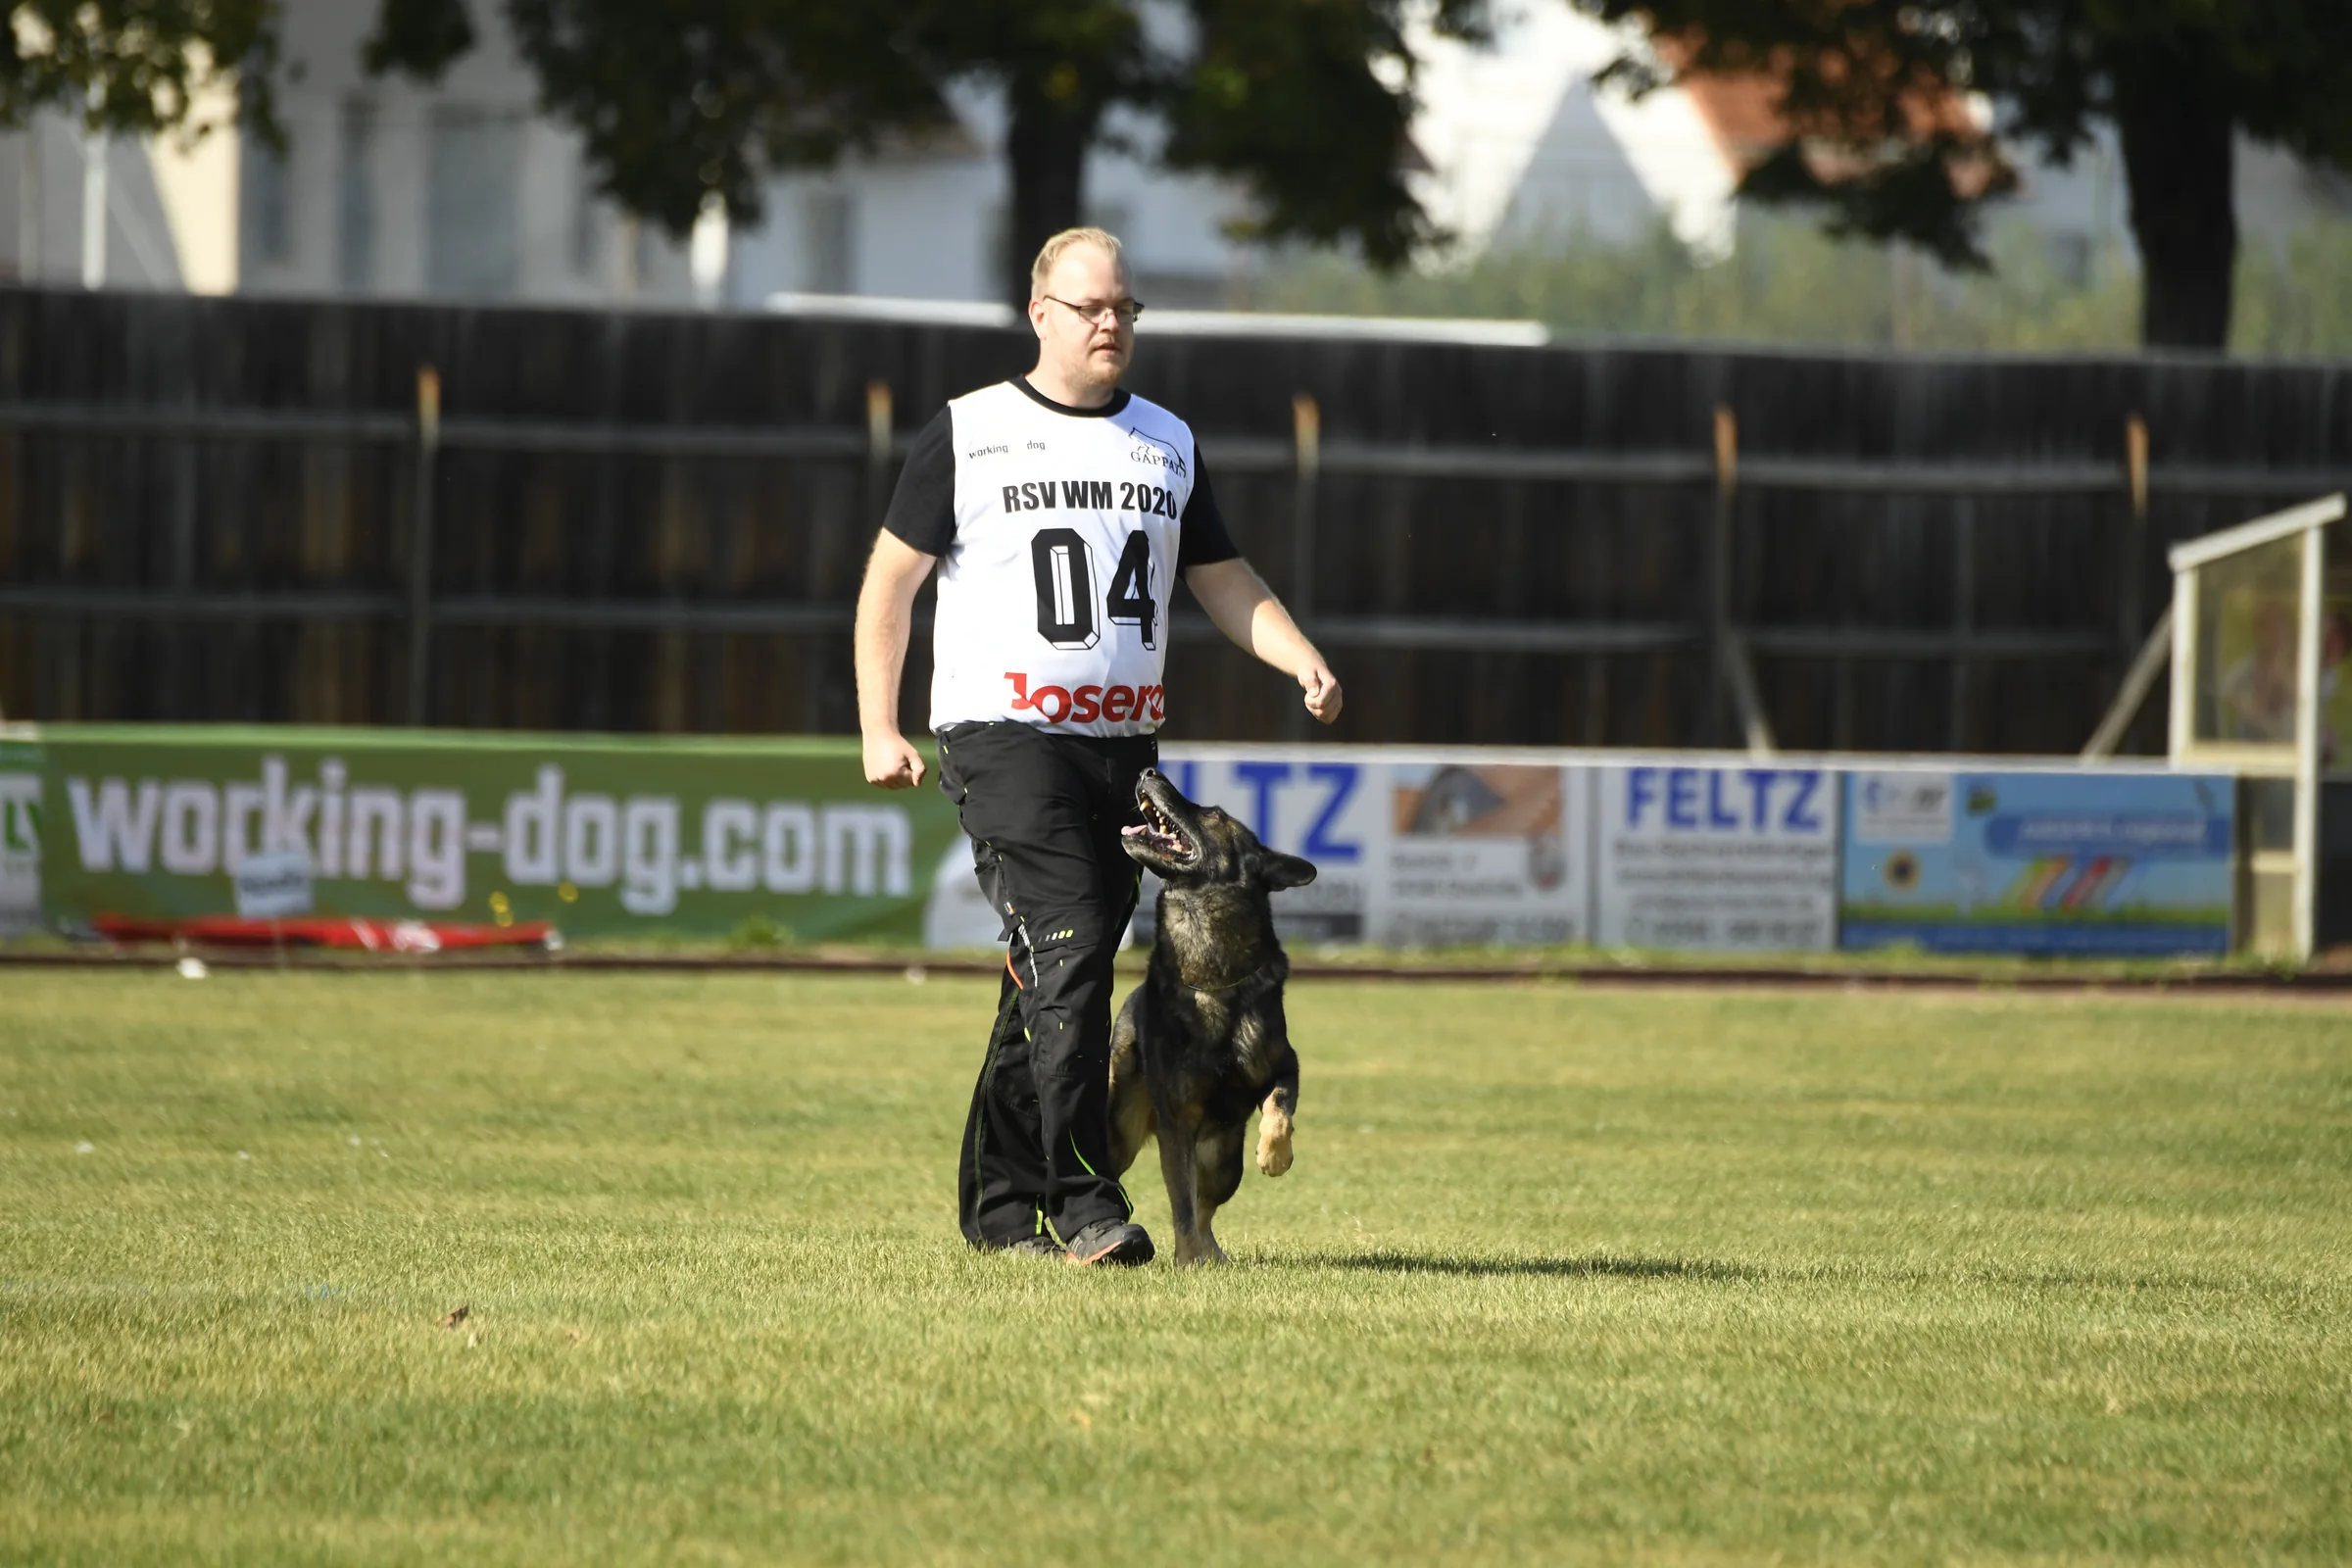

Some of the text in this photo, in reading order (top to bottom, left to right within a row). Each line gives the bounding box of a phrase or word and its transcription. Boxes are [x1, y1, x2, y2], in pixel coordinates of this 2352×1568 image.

[968, 439, 1046, 460] working dog
[1002, 480, 1177, 520] RSV WM 2020
[1030, 527, 1159, 652] 04
[1624, 767, 1824, 831] FELTZ
[67, 753, 912, 915] working-dog.com
